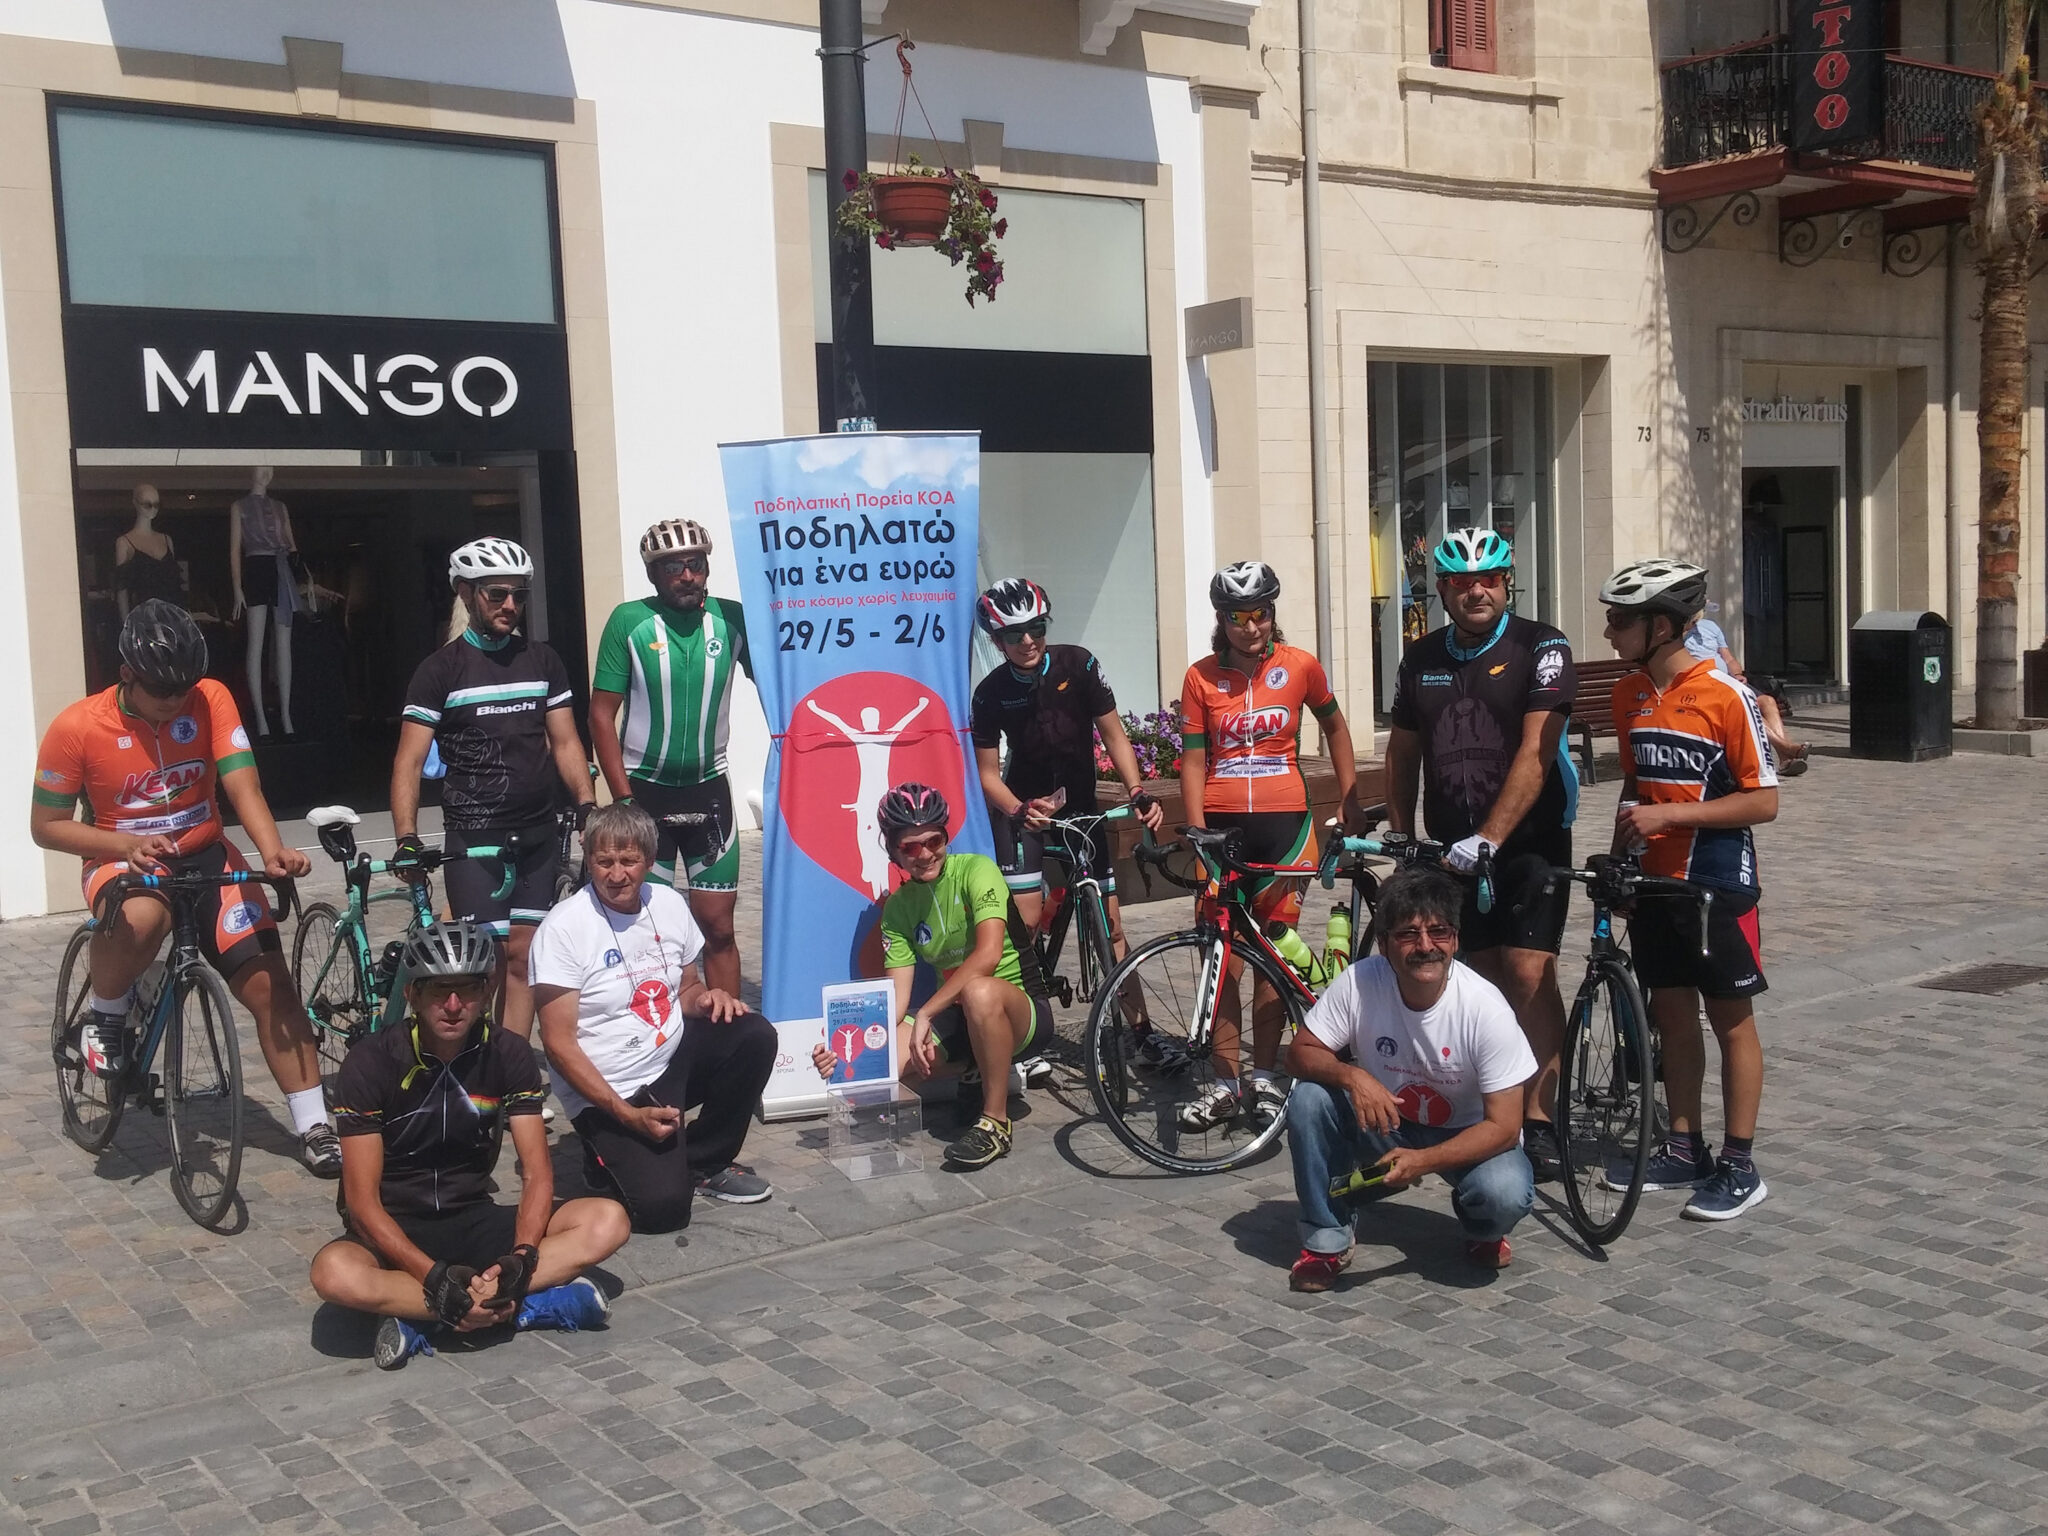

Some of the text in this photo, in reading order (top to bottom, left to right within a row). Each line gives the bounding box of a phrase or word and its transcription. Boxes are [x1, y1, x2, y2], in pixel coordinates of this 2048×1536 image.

[1812, 0, 1850, 130] TOO
[1189, 329, 1238, 349] MANGO
[142, 346, 519, 418] MANGO
[1741, 395, 1848, 423] stradivarius
[1637, 426, 1652, 442] 73
[1696, 427, 1710, 443] 75
[754, 493, 851, 515] Ποδηλατική
[856, 490, 913, 509] Πορεία
[759, 509, 956, 554] Ποδηλατώ
[764, 551, 956, 594] για ένα ευρώ
[769, 600, 783, 614] για
[787, 596, 806, 609] ένα
[810, 594, 854, 609] κόσμο
[858, 590, 897, 608] χωρίς
[779, 617, 855, 654] 29/5
[894, 612, 946, 648] 2/6
[1422, 673, 1454, 681] Bianchi
[476, 701, 537, 716] Bianchi
[1219, 712, 1283, 746] KEAN
[121, 765, 201, 805] KEAN
